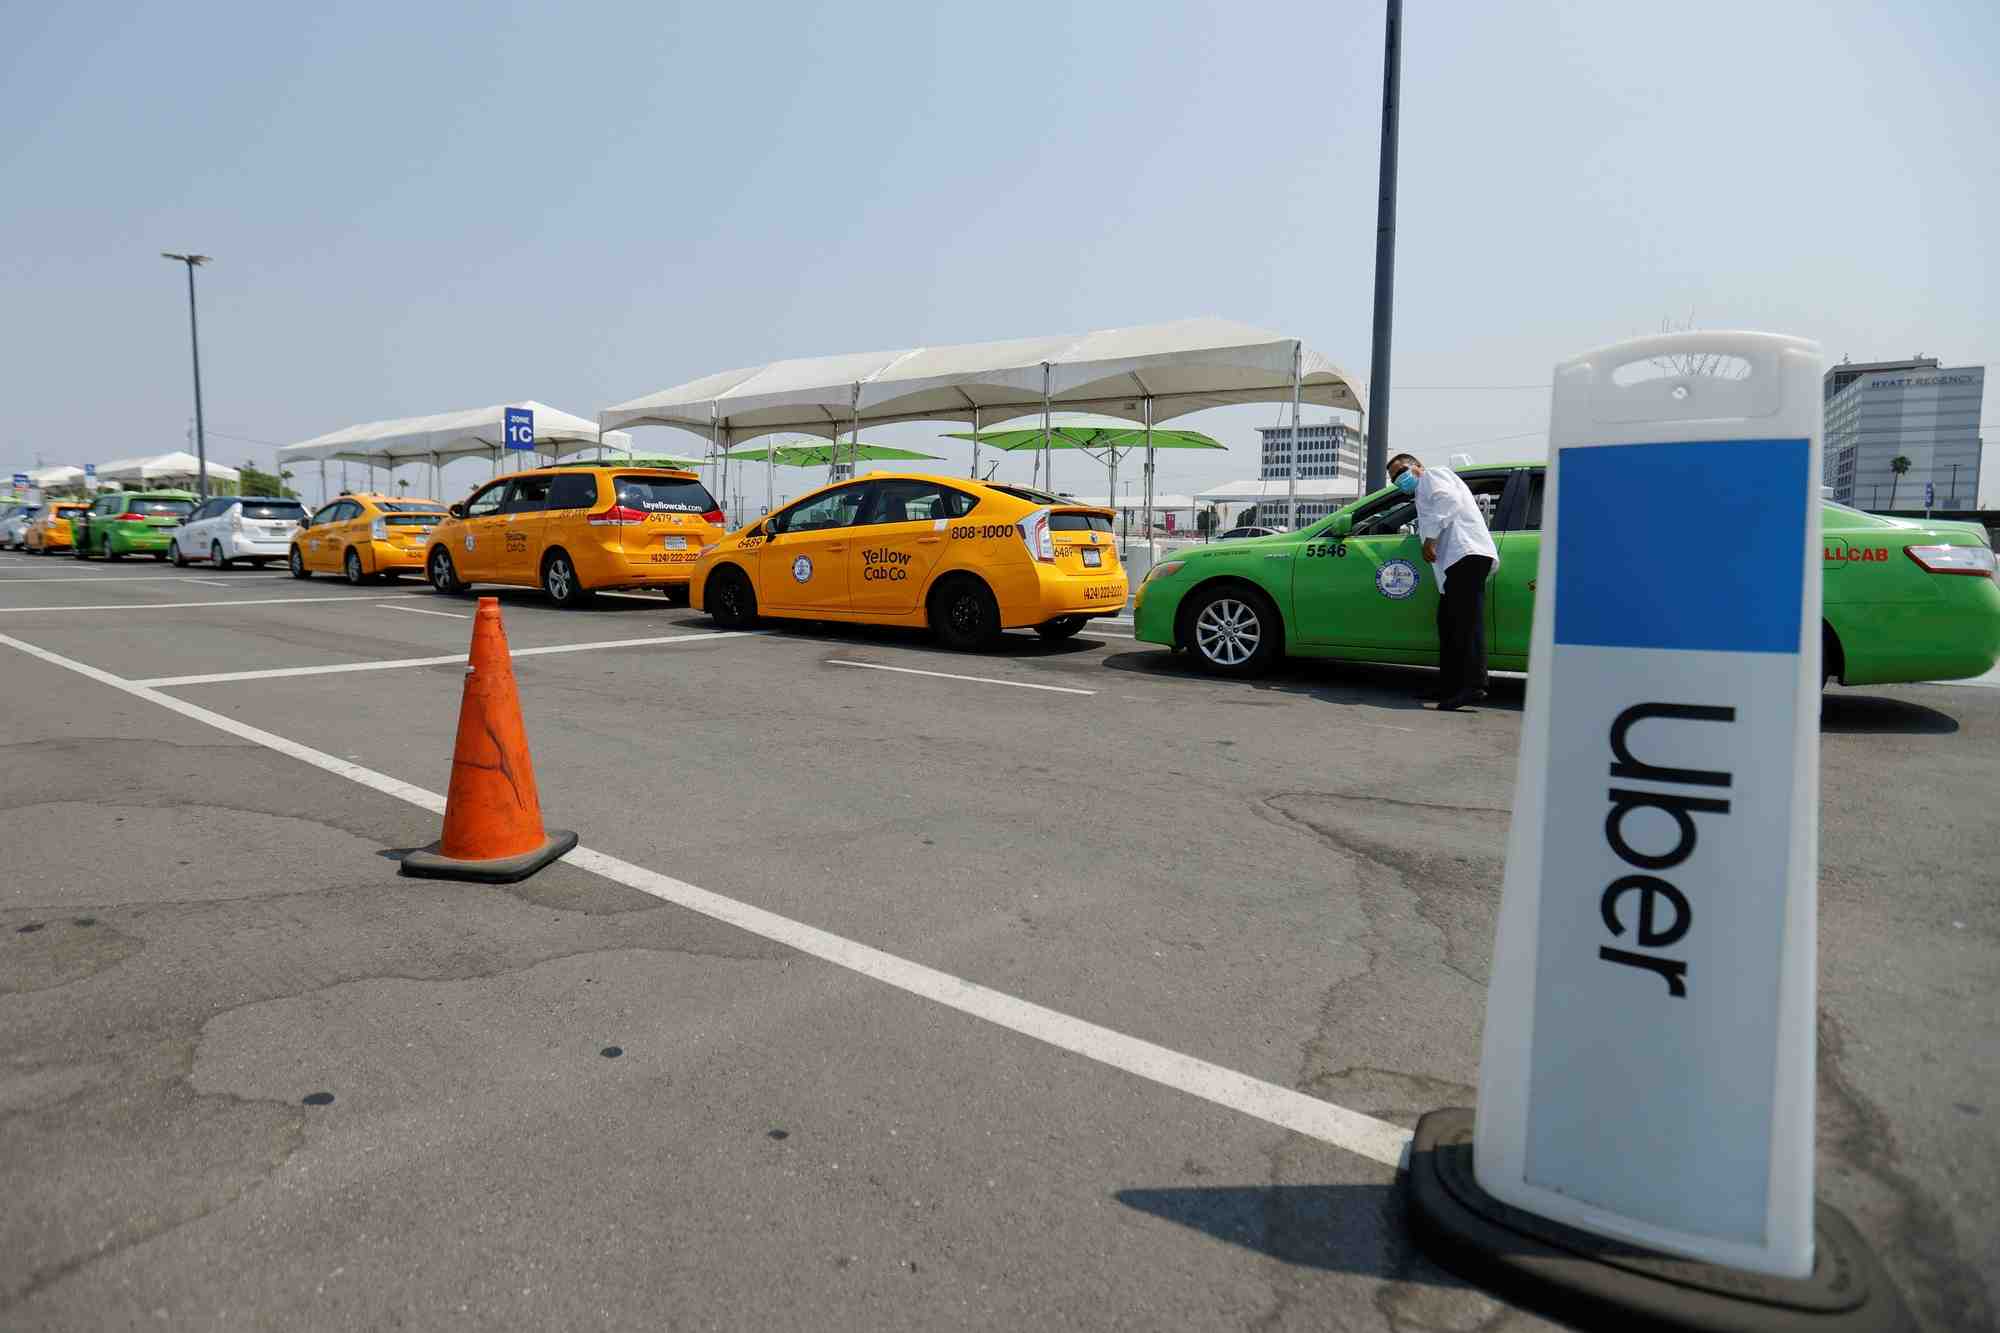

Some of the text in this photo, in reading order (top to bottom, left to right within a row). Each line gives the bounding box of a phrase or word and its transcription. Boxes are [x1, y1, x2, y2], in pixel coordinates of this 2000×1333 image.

[509, 425, 532, 442] 1C
[951, 524, 1013, 539] 808-1000
[862, 547, 911, 565] Yellow
[1306, 543, 1347, 558] 5546
[1823, 547, 1888, 561] LLCAB
[1598, 702, 1735, 998] Uber
